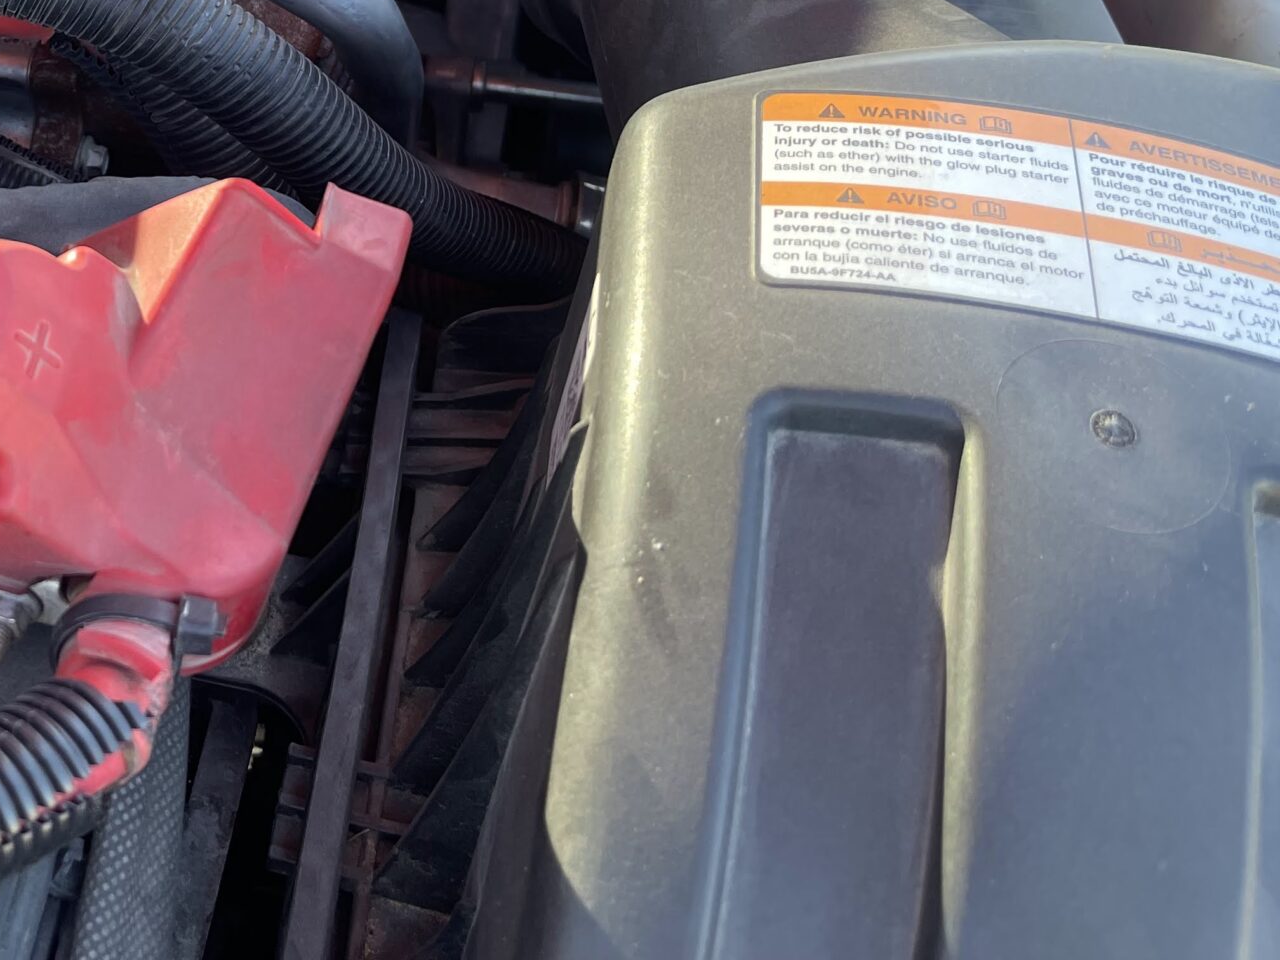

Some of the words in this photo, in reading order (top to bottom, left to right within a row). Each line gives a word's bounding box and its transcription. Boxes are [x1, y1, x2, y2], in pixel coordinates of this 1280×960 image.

[858, 105, 967, 126] WARNING
[774, 123, 792, 133] To
[796, 124, 848, 134] reduce
[852, 125, 881, 136] risk
[885, 128, 901, 137] of
[905, 130, 972, 144] possible
[975, 137, 1035, 153] serious
[774, 136, 817, 147] injury
[821, 138, 836, 146] or
[841, 138, 890, 149] death:
[894, 141, 915, 151] Do
[920, 143, 944, 154] not
[947, 147, 974, 158] use
[978, 150, 1026, 164] starter
[1029, 155, 1069, 171] fluids
[773, 161, 816, 172] assist
[818, 164, 837, 172] on
[841, 163, 865, 174] the
[868, 165, 923, 178] engine.
[774, 148, 813, 159] (such
[817, 151, 834, 159] as
[838, 150, 881, 163] ether)
[885, 153, 915, 165] with
[919, 156, 942, 167] the
[946, 160, 981, 172] glow
[985, 164, 1017, 178] plug
[1021, 169, 1070, 184] starter
[1088, 152, 1127, 168] Pour
[1130, 161, 1186, 181] réduire
[1190, 174, 1204, 185] le
[1207, 179, 1256, 200] risque
[1258, 193, 1277, 206] de
[1128, 140, 1280, 188] AVERTISSEME
[886, 192, 958, 210] AVISO
[1090, 166, 1144, 183] graves
[1148, 177, 1168, 188] ou
[1172, 182, 1192, 193] de
[1240, 199, 1280, 219] n'utilis
[1092, 176, 1141, 194] fluides
[1145, 188, 1164, 199] de
[1168, 192, 1246, 219] démarrage
[1250, 212, 1280, 230] (tels
[773, 209, 809, 219] Para
[814, 210, 871, 222] reducir
[875, 213, 890, 224] el
[894, 216, 946, 232] riesgo
[951, 222, 971, 233] de
[976, 225, 1046, 244] lesiones
[1094, 190, 1130, 204] avec
[1134, 198, 1152, 208] ce
[1156, 203, 1208, 221] moteur
[1212, 214, 1260, 236] équipé
[1096, 202, 1115, 213] de
[1120, 205, 1221, 237] préchauffage.
[773, 223, 835, 234] severas
[840, 226, 851, 234] o
[855, 227, 918, 240] muerte:
[923, 232, 945, 244] No
[950, 237, 977, 249] use
[1038, 249, 1058, 260] de
[773, 238, 841, 249] arranque
[845, 240, 893, 253] (como
[897, 243, 933, 259] éter)
[938, 250, 951, 259] si
[956, 252, 1016, 269] arranca
[1020, 261, 1034, 271] el
[1039, 265, 1085, 280] motor
[772, 251, 800, 261] con
[804, 251, 818, 261] la
[864, 256, 926, 270] caliente
[929, 263, 950, 274] de
[954, 268, 1031, 286] arranque.
[790, 265, 896, 281] BU5A-9F724-AA
